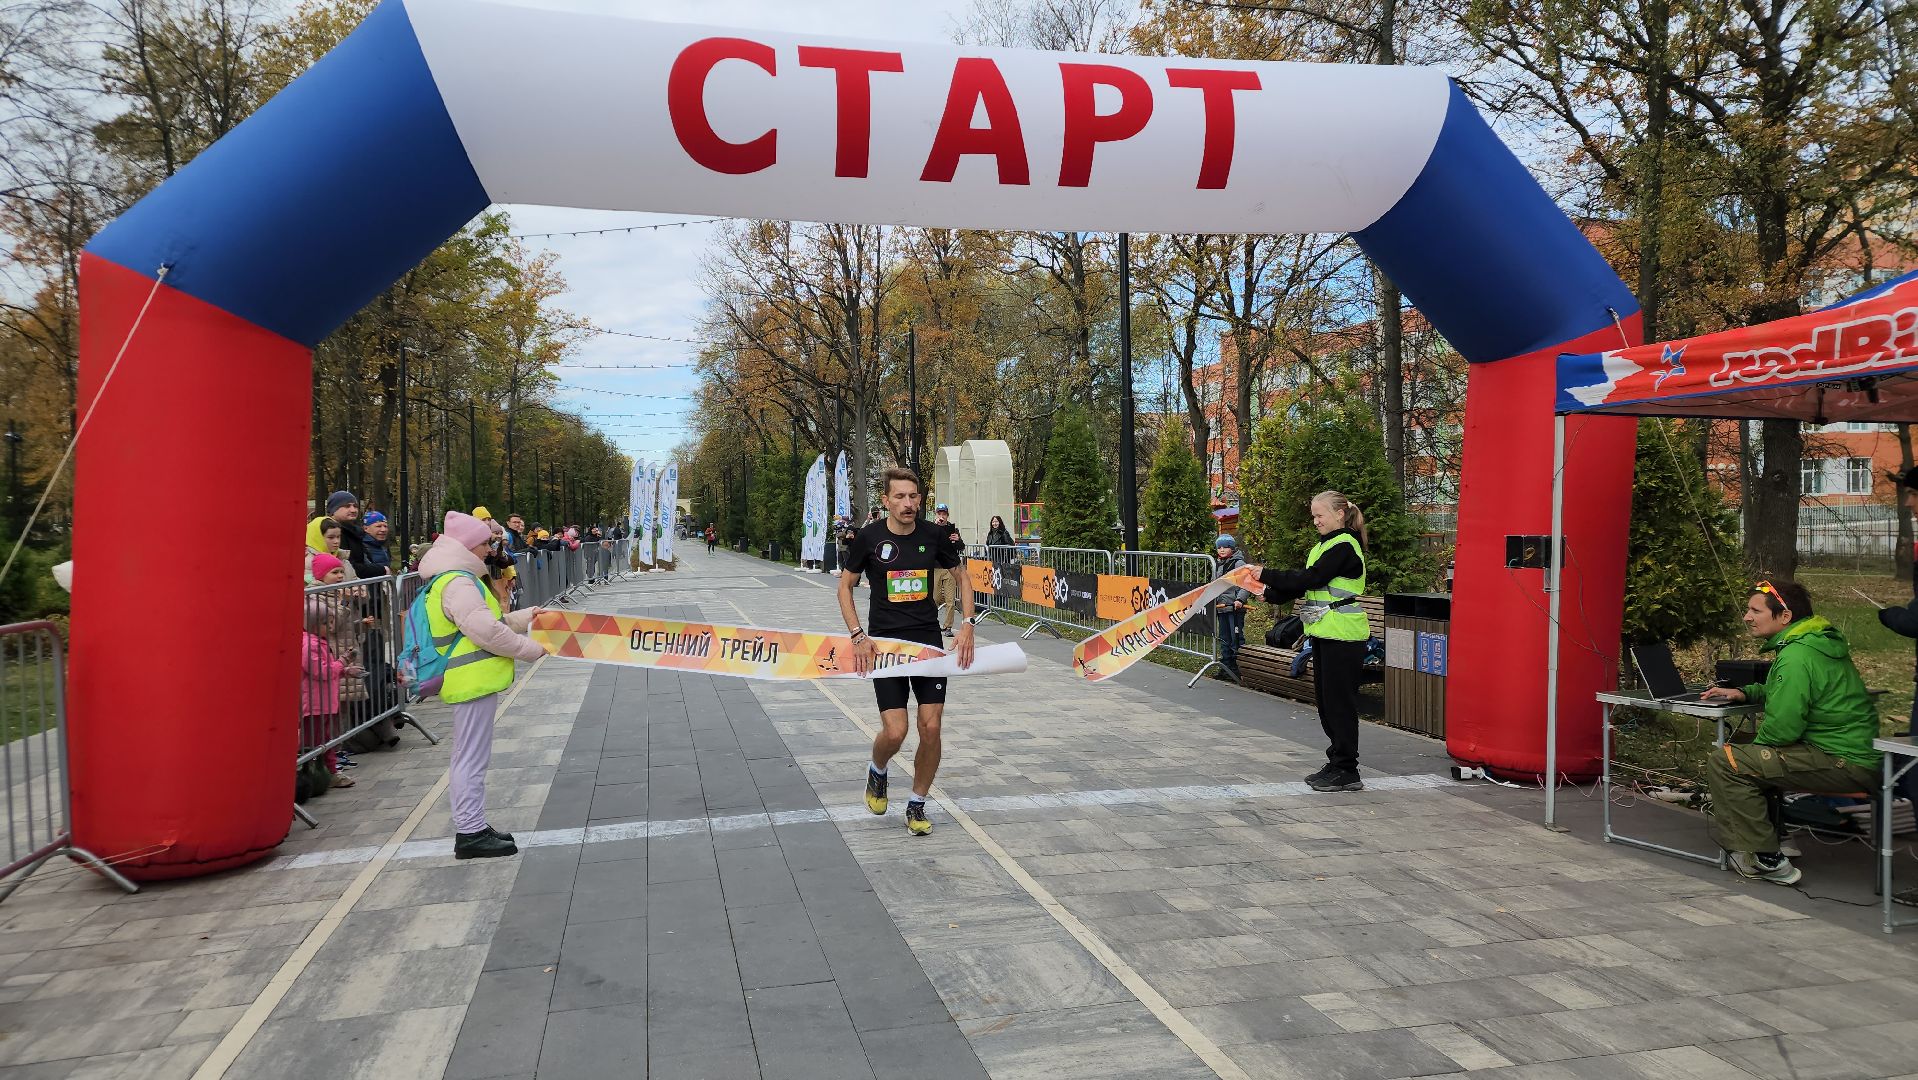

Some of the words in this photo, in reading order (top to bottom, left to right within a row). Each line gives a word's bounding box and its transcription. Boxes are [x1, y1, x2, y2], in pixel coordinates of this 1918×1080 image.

[668, 37, 1262, 189] СТАРТ
[892, 579, 923, 593] 140
[630, 629, 711, 658] ОСЕННИЙ
[720, 635, 778, 664] ТРЕЙЛ
[1111, 620, 1169, 657] «КРАСКИ
